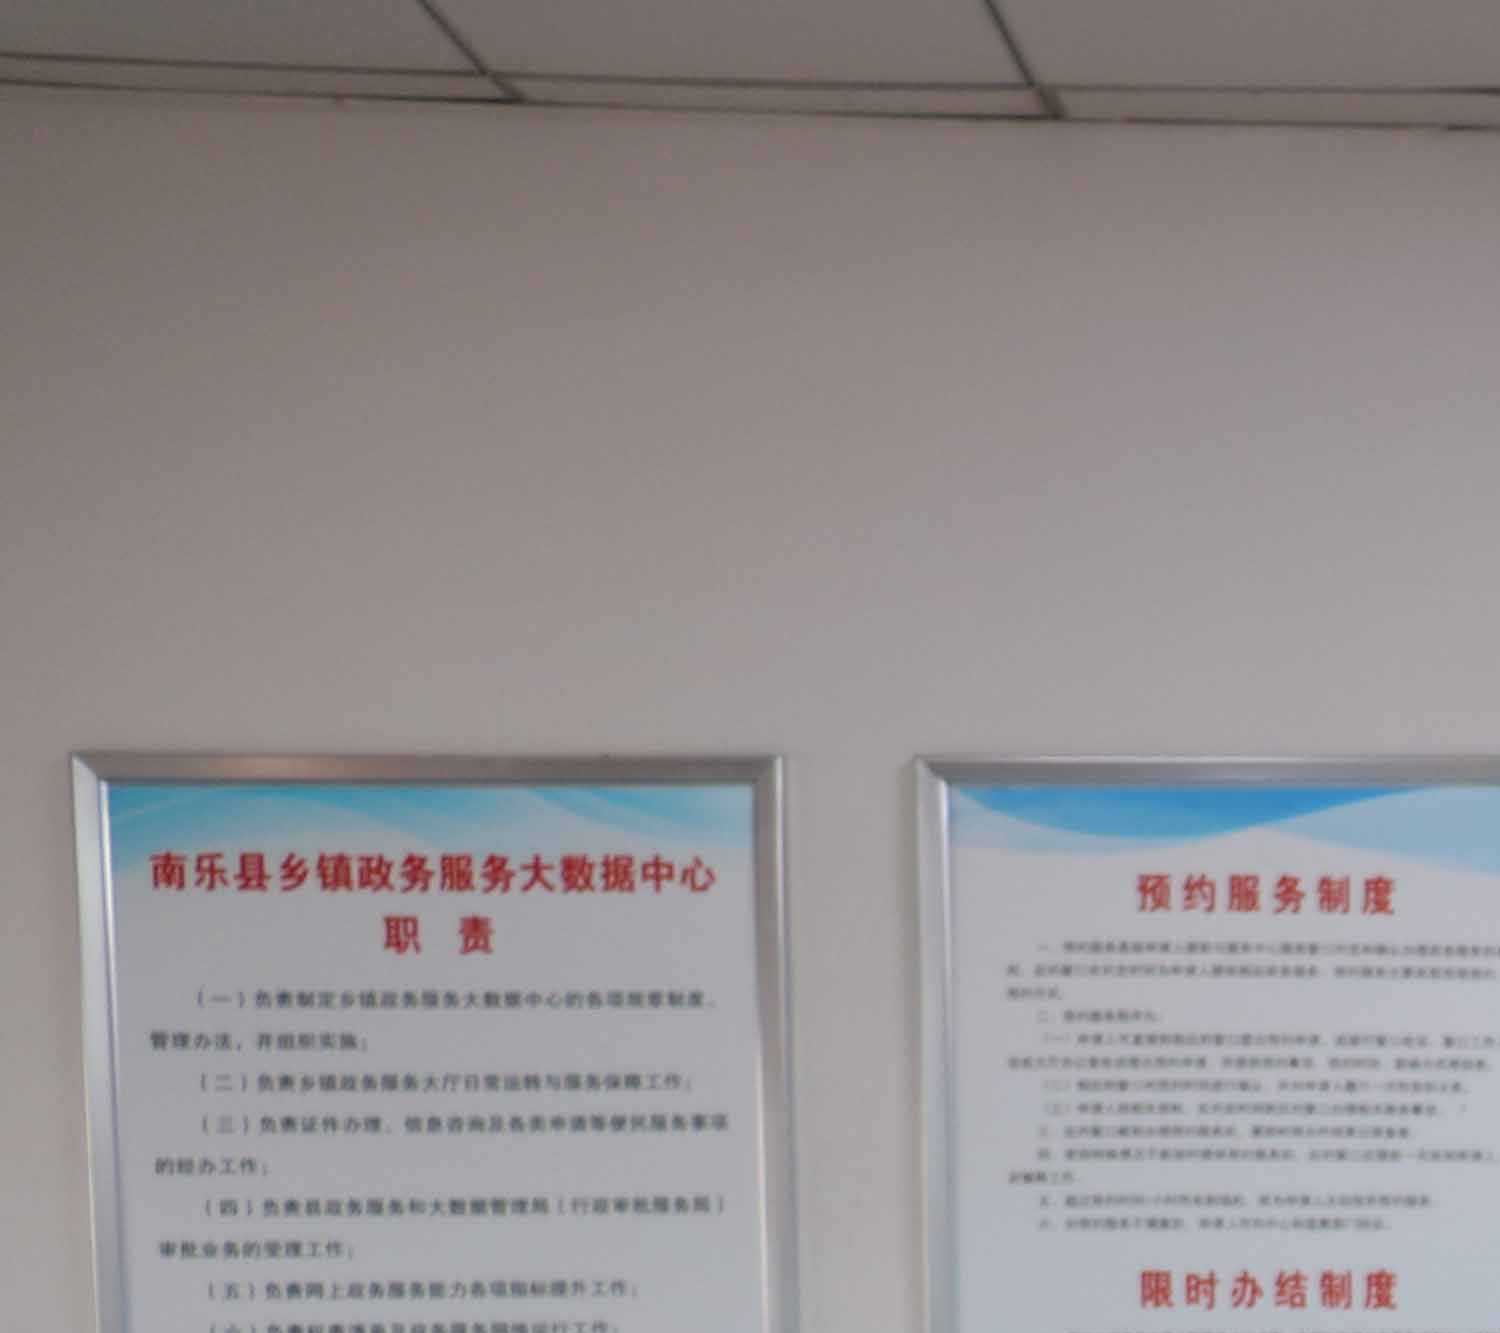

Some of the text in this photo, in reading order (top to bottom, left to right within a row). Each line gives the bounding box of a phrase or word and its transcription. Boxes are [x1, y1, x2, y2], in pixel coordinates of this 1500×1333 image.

[150, 850, 717, 896] 南乐县乡镇政务服务大数据中心
[1136, 871, 1394, 914] 预约服务制度
[383, 912, 493, 957] 职 责
[1139, 1267, 1397, 1312] 限时办结制度
